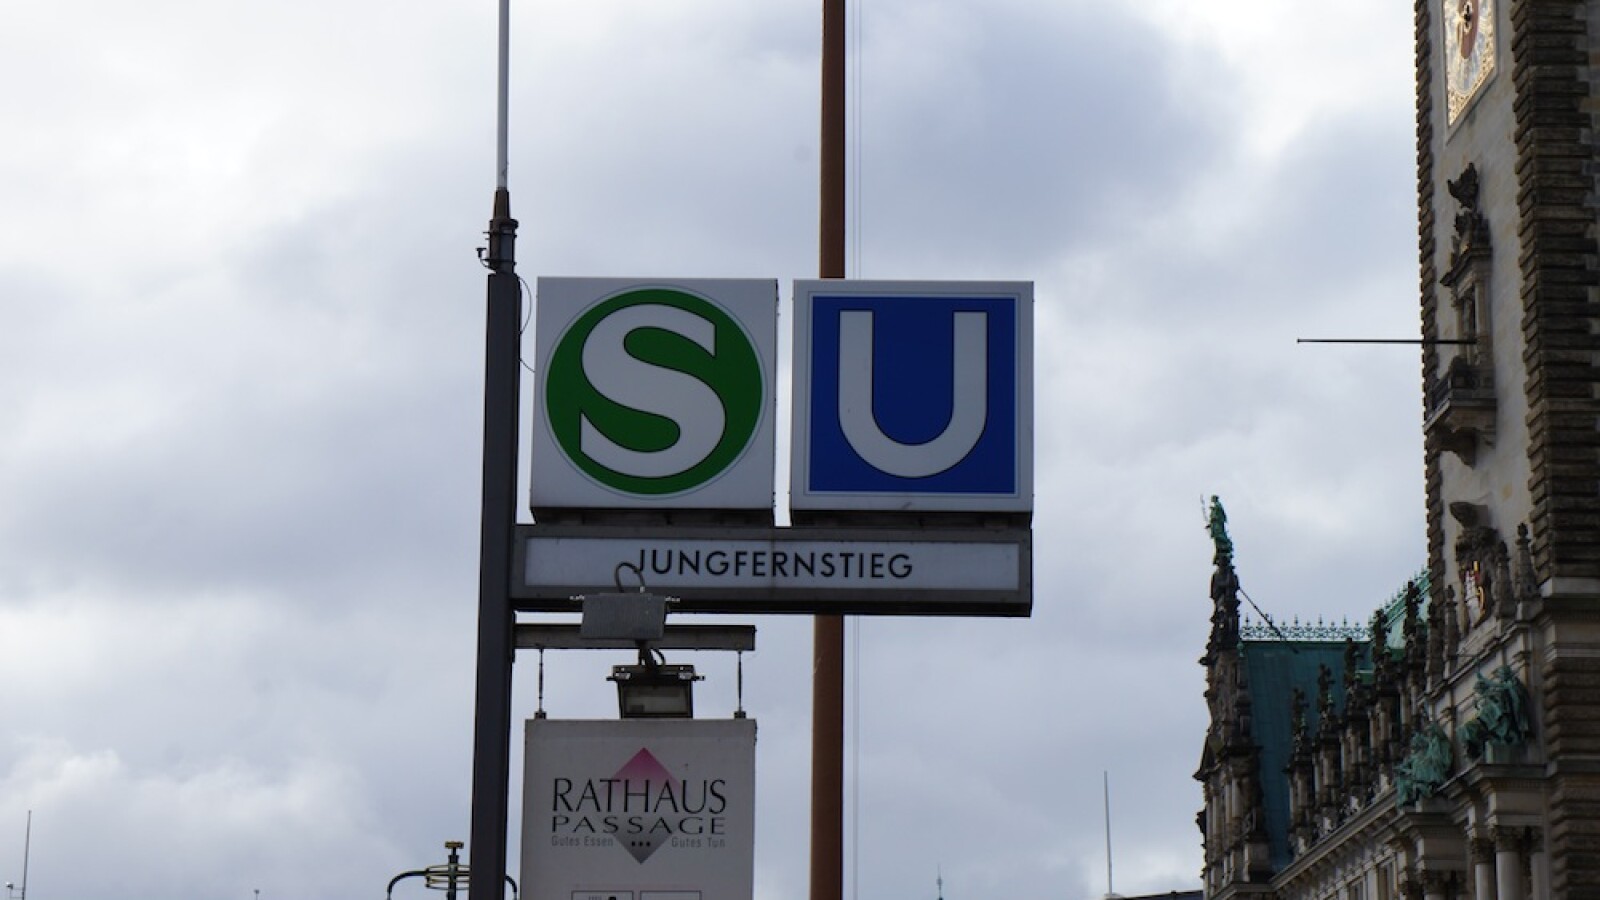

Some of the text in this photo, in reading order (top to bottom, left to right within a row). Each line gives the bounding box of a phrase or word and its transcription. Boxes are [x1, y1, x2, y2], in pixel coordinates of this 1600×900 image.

[580, 302, 726, 479] S
[837, 309, 989, 479] U
[637, 549, 913, 578] JUNGFERNSTIEG
[552, 778, 727, 814] RATHAUS
[551, 835, 726, 848] Gutes Essen Gutes Tun
[552, 816, 726, 835] PASSAGE
